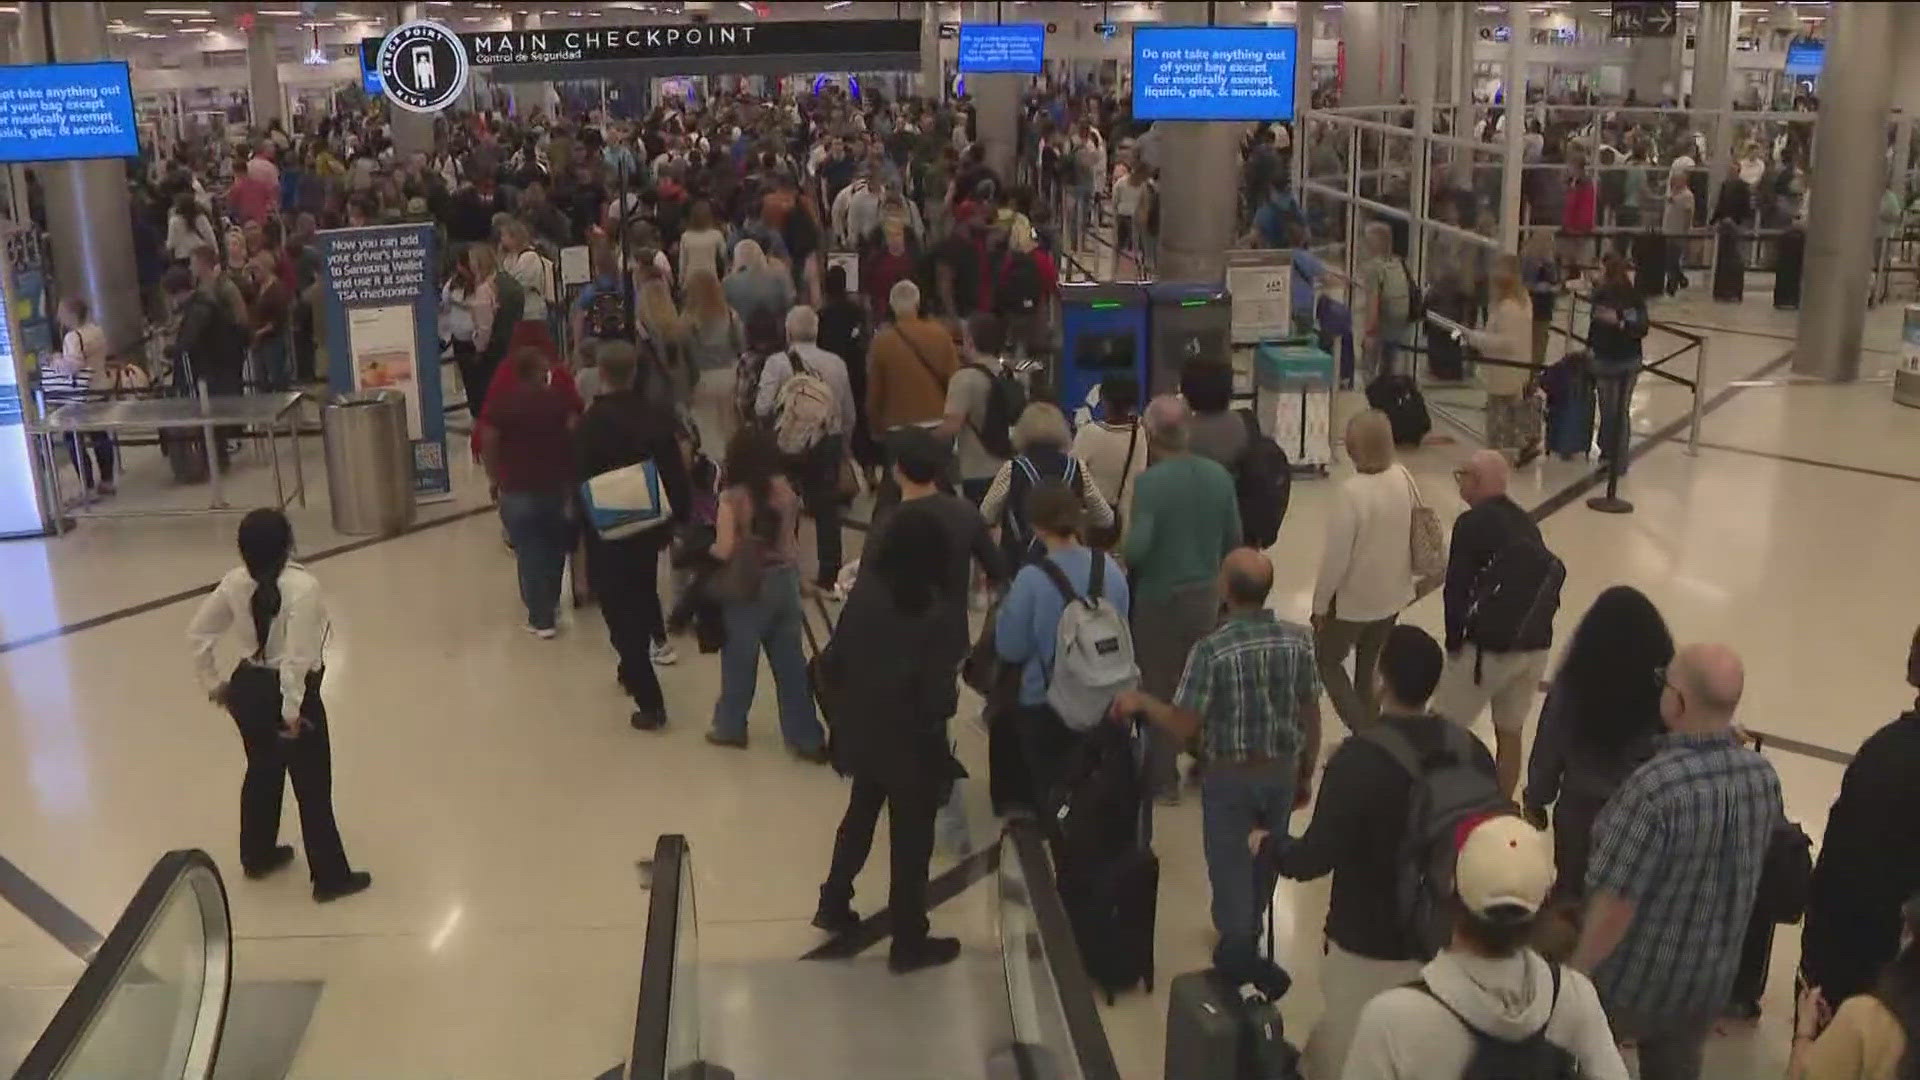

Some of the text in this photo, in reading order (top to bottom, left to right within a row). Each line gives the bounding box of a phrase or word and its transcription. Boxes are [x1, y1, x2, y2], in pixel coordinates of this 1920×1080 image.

[475, 27, 755, 52] MAIN CHECKPOINT
[476, 49, 582, 64] Control de Seguridad
[1142, 49, 1287, 62] Do not take anything out
[383, 28, 443, 106] MAIN CHECK POINT
[1160, 62, 1268, 74] of your bag except
[1153, 74, 1273, 87] for medically exempt
[0, 85, 121, 101] ot take anything out
[1144, 86, 1281, 98] liquids, gels, & aerosols.
[10, 103, 38, 115] your
[40, 100, 63, 112] bag
[66, 99, 106, 112] except
[11, 112, 67, 126] medically
[69, 112, 113, 124] exempt
[30, 126, 56, 139] gels,
[59, 125, 71, 136] &
[332, 234, 418, 251] Now you can add
[327, 253, 350, 266] your
[392, 248, 426, 259] license
[331, 260, 423, 277] to Samsung Wallet
[332, 272, 423, 290] and use it at select
[337, 290, 359, 302] TSA
